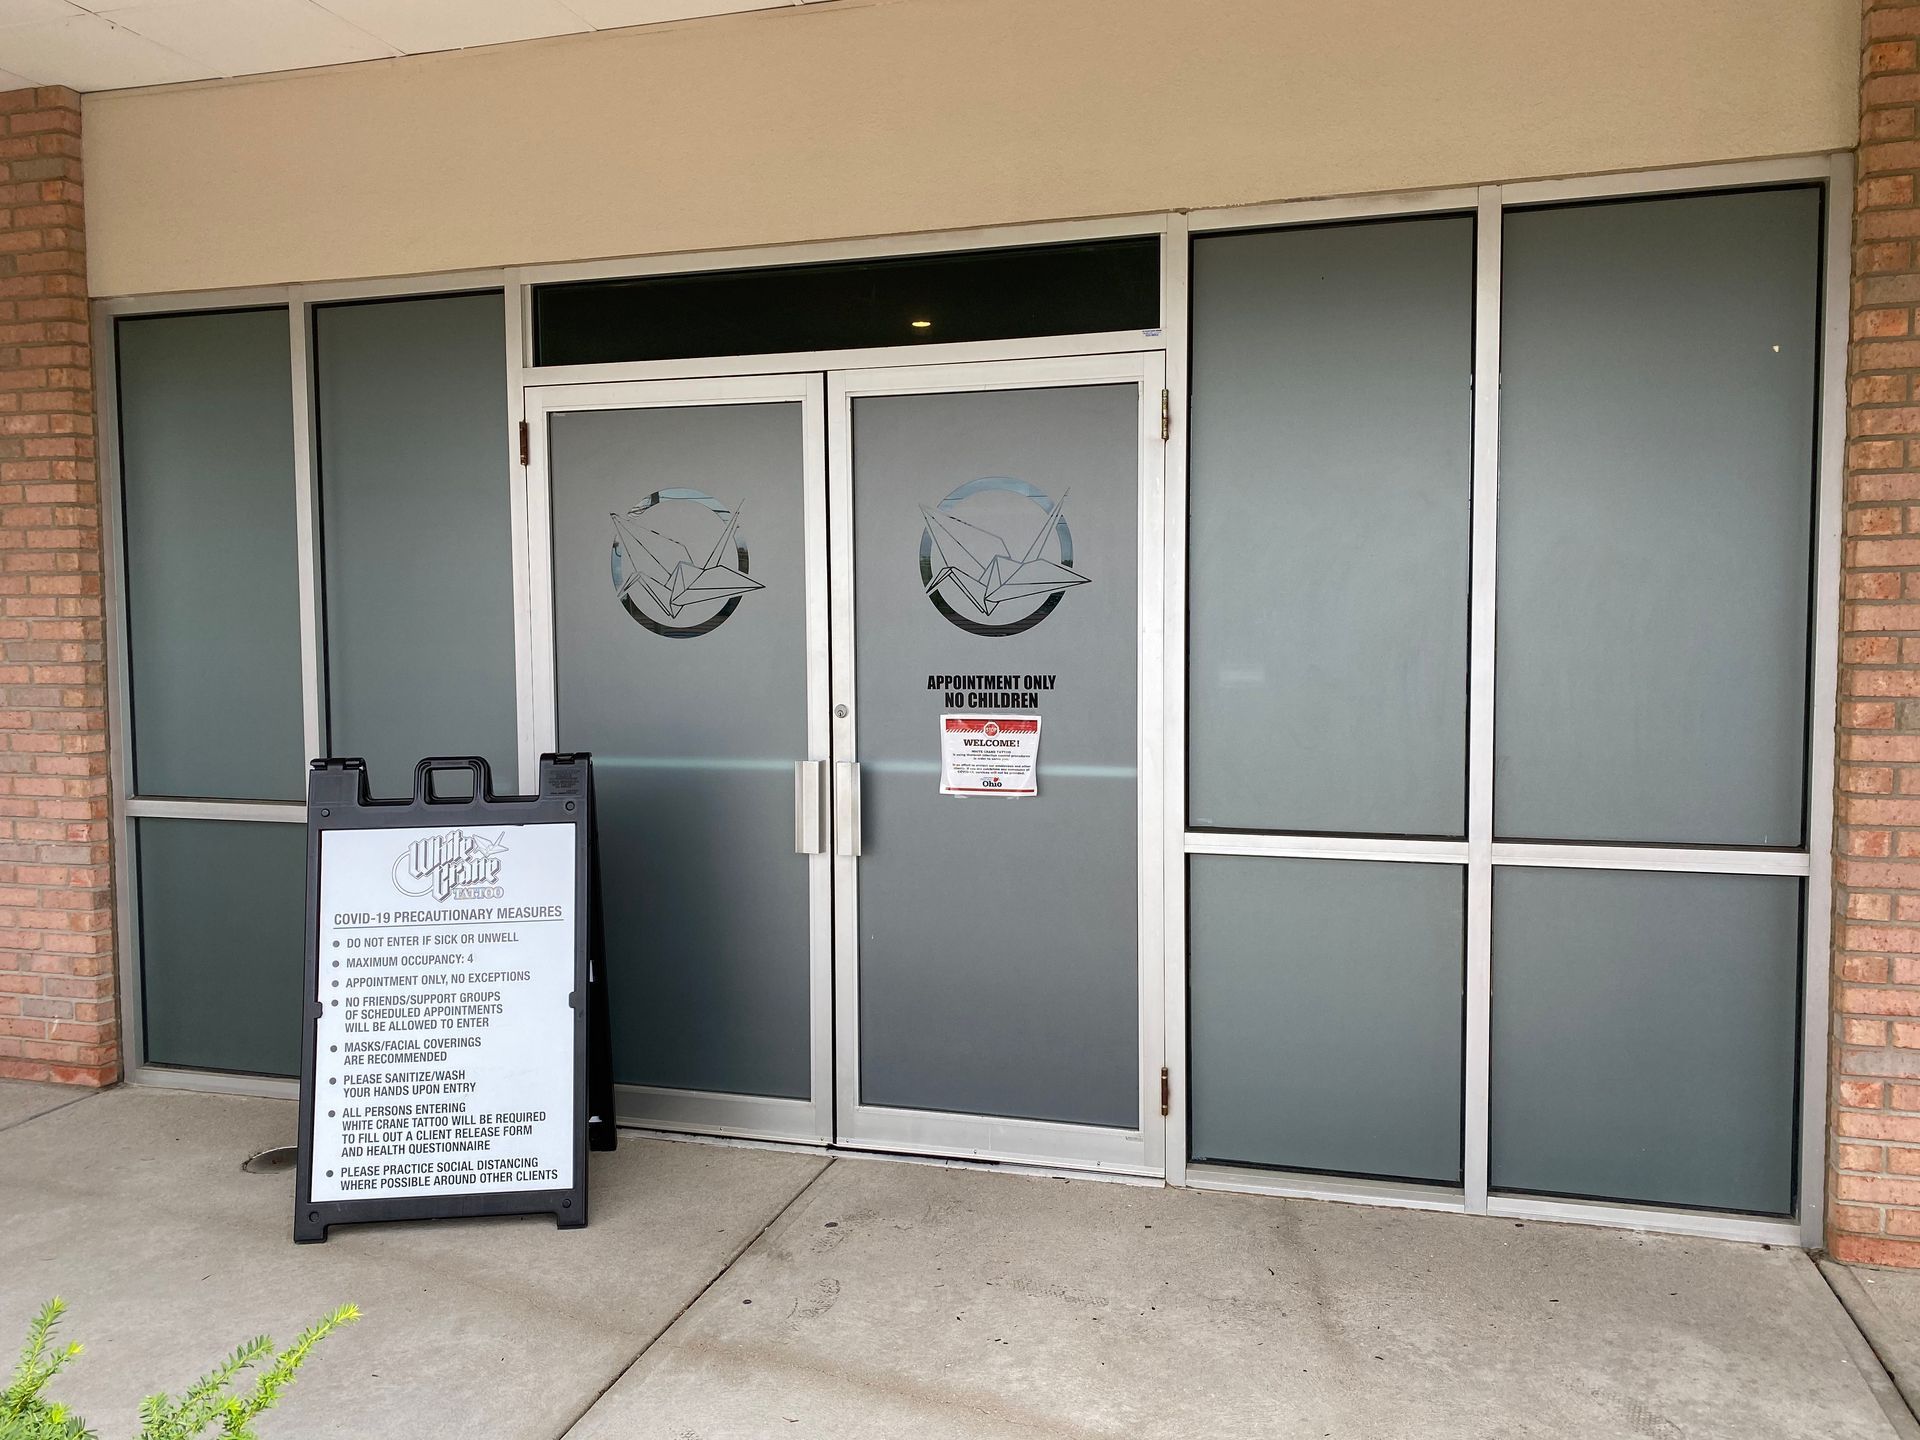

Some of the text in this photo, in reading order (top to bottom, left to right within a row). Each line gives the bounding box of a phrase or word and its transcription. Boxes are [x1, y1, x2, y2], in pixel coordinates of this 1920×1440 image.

[928, 675, 1056, 689] APPOINTMENT ONLY
[946, 693, 1038, 708] NO CHILDREN
[964, 739, 1020, 747] WELCOME!
[408, 829, 476, 879] White
[432, 856, 502, 903] Crane
[454, 886, 504, 900] TATTOO
[335, 906, 562, 925] COVID-19 PRECAUTIONARY MEASURES
[347, 932, 519, 948] DO NOT ENTER IF SICK OR UNWELL
[347, 954, 473, 968] MAXIMUM OCCUPANCY: 4
[346, 971, 530, 988] APPOINTMENT ONLY, NO EXCEPTIONS
[346, 991, 500, 1007] NO FRIENDS/SUPPORT GROUPS
[345, 1004, 503, 1020] OF SCHEDULED APPOINTMENTS
[345, 1017, 489, 1032] WILL BE ALLOWED TO ENTER
[345, 1037, 481, 1052] MASKS/FACIAL COVERINGS
[344, 1051, 447, 1065] ARE RECOMMENDED
[344, 1070, 465, 1085] PLEASE SANITIZE/WASH
[344, 1082, 476, 1098] YOUR HANDS UPON ENTRY
[342, 1102, 466, 1118] ALL PERSONS ENTERING
[342, 1111, 546, 1131] WHITE CRANE TATTOO WILL BE REQUIRED
[342, 1125, 532, 1144] TO FILL OUT A CLIENT RELEASE FORM
[341, 1140, 490, 1157] AND HEALTH QUESTIONNAIRE
[341, 1157, 538, 1177] PLEASE PRACTICE SOCIAL DISTANCING
[340, 1169, 558, 1191] WHERE POSSIBLE AROUND OTHER CLIENTS
